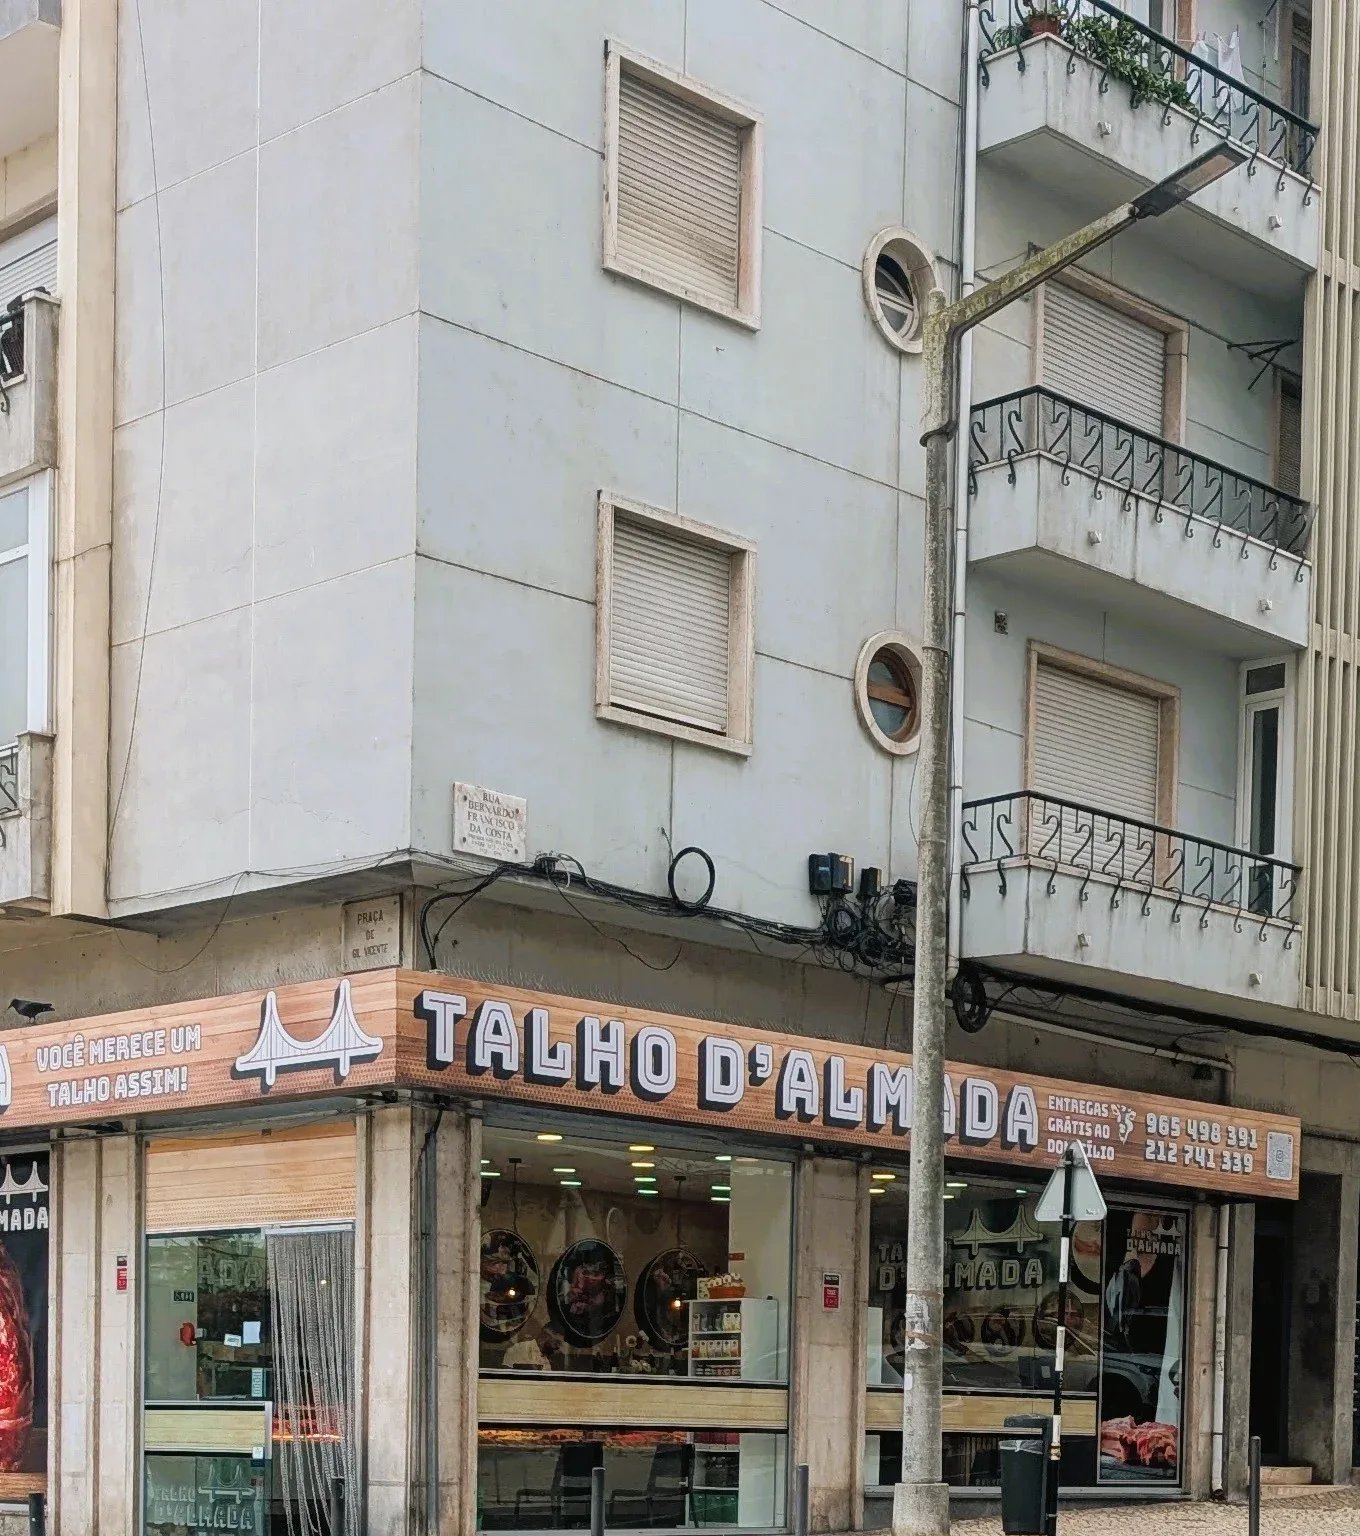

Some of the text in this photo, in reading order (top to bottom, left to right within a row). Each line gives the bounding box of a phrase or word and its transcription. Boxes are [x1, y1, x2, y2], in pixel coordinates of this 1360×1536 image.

[482, 792, 500, 805] RUA
[468, 800, 515, 819] BERNARDO
[469, 823, 512, 842] DA COSTA
[357, 909, 384, 926] PRAÇA
[365, 929, 375, 941] DE
[352, 943, 389, 959] GIL VICENTE
[36, 1024, 202, 1072] VOCÊ MERECE UM
[414, 989, 1039, 1147] TALHO D'ALMDA
[47, 1066, 189, 1108] TALHO ASSIM!
[1048, 1095, 1109, 1117] ENTREGAS
[1048, 1115, 1110, 1139] GRÁTIS AO
[1146, 1112, 1258, 1149] 965 498 391
[1145, 1139, 1253, 1174] 212 741 339
[1126, 1239, 1181, 1256] D'ALMADA
